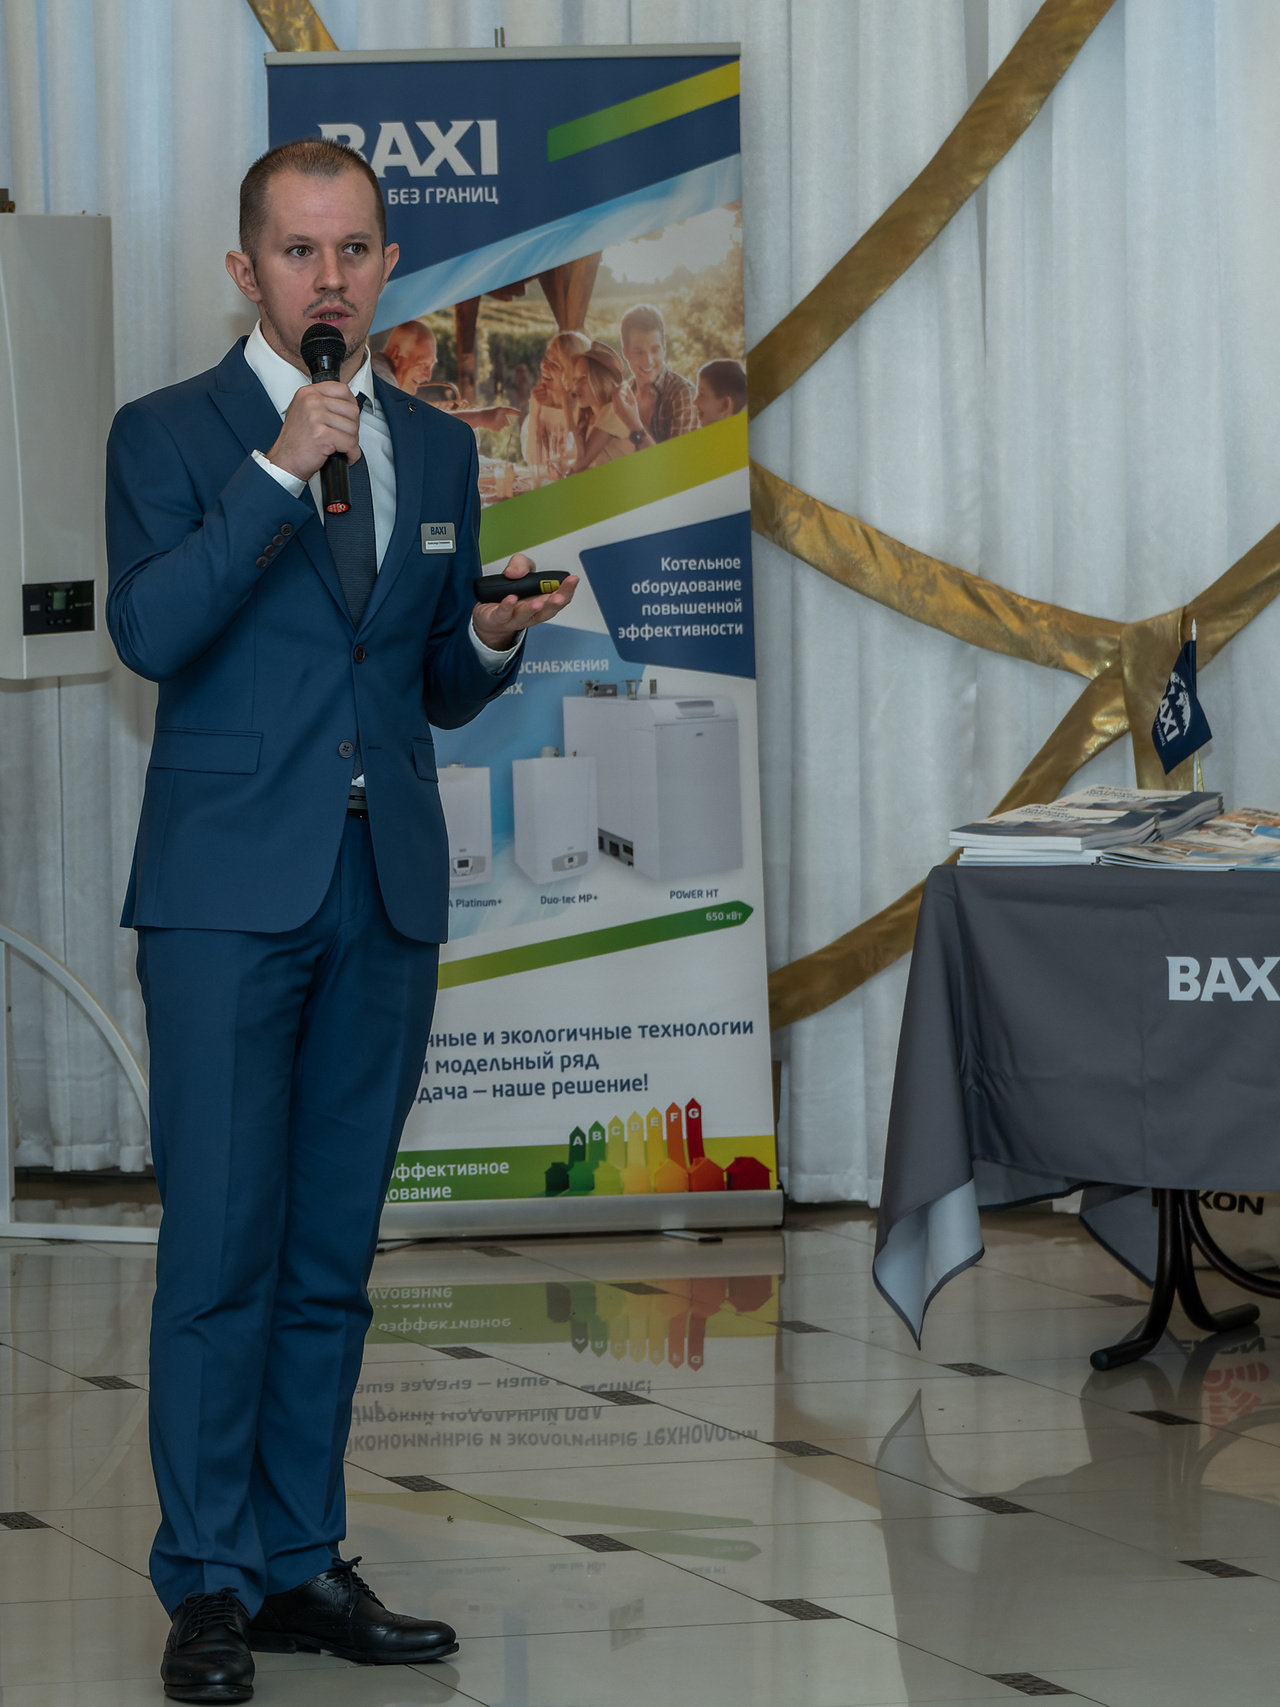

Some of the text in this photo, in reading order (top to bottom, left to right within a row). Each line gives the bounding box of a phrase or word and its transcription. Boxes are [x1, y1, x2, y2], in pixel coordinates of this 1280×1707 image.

[387, 186, 499, 206] БЕЗ ГРАНИЦ
[430, 526, 447, 535] BAXI
[661, 557, 741, 572] Котельное
[631, 580, 742, 597] оборудование
[642, 598, 743, 616] повышенной
[618, 623, 744, 641] эффективности
[540, 894, 598, 905] Duo-tec MP+
[669, 889, 719, 899] POWER HT
[456, 899, 503, 908] Platinum+
[705, 911, 742, 921] 650 кВт
[483, 1032, 495, 1044] и
[501, 1023, 631, 1045] экологичные
[638, 1020, 754, 1039] технологии
[435, 1052, 554, 1076] модельный
[560, 1053, 599, 1073] ряд
[416, 1085, 468, 1104] дача
[492, 1082, 545, 1098] наше
[552, 1074, 648, 1099] решение!
[670, 1112, 678, 1122] F
[688, 1108, 699, 1119] G
[631, 1122, 640, 1131] D
[650, 1117, 659, 1127] E
[592, 1131, 602, 1141] B
[611, 1126, 620, 1136] C
[572, 1136, 583, 1146] A
[386, 1186, 452, 1203] ование
